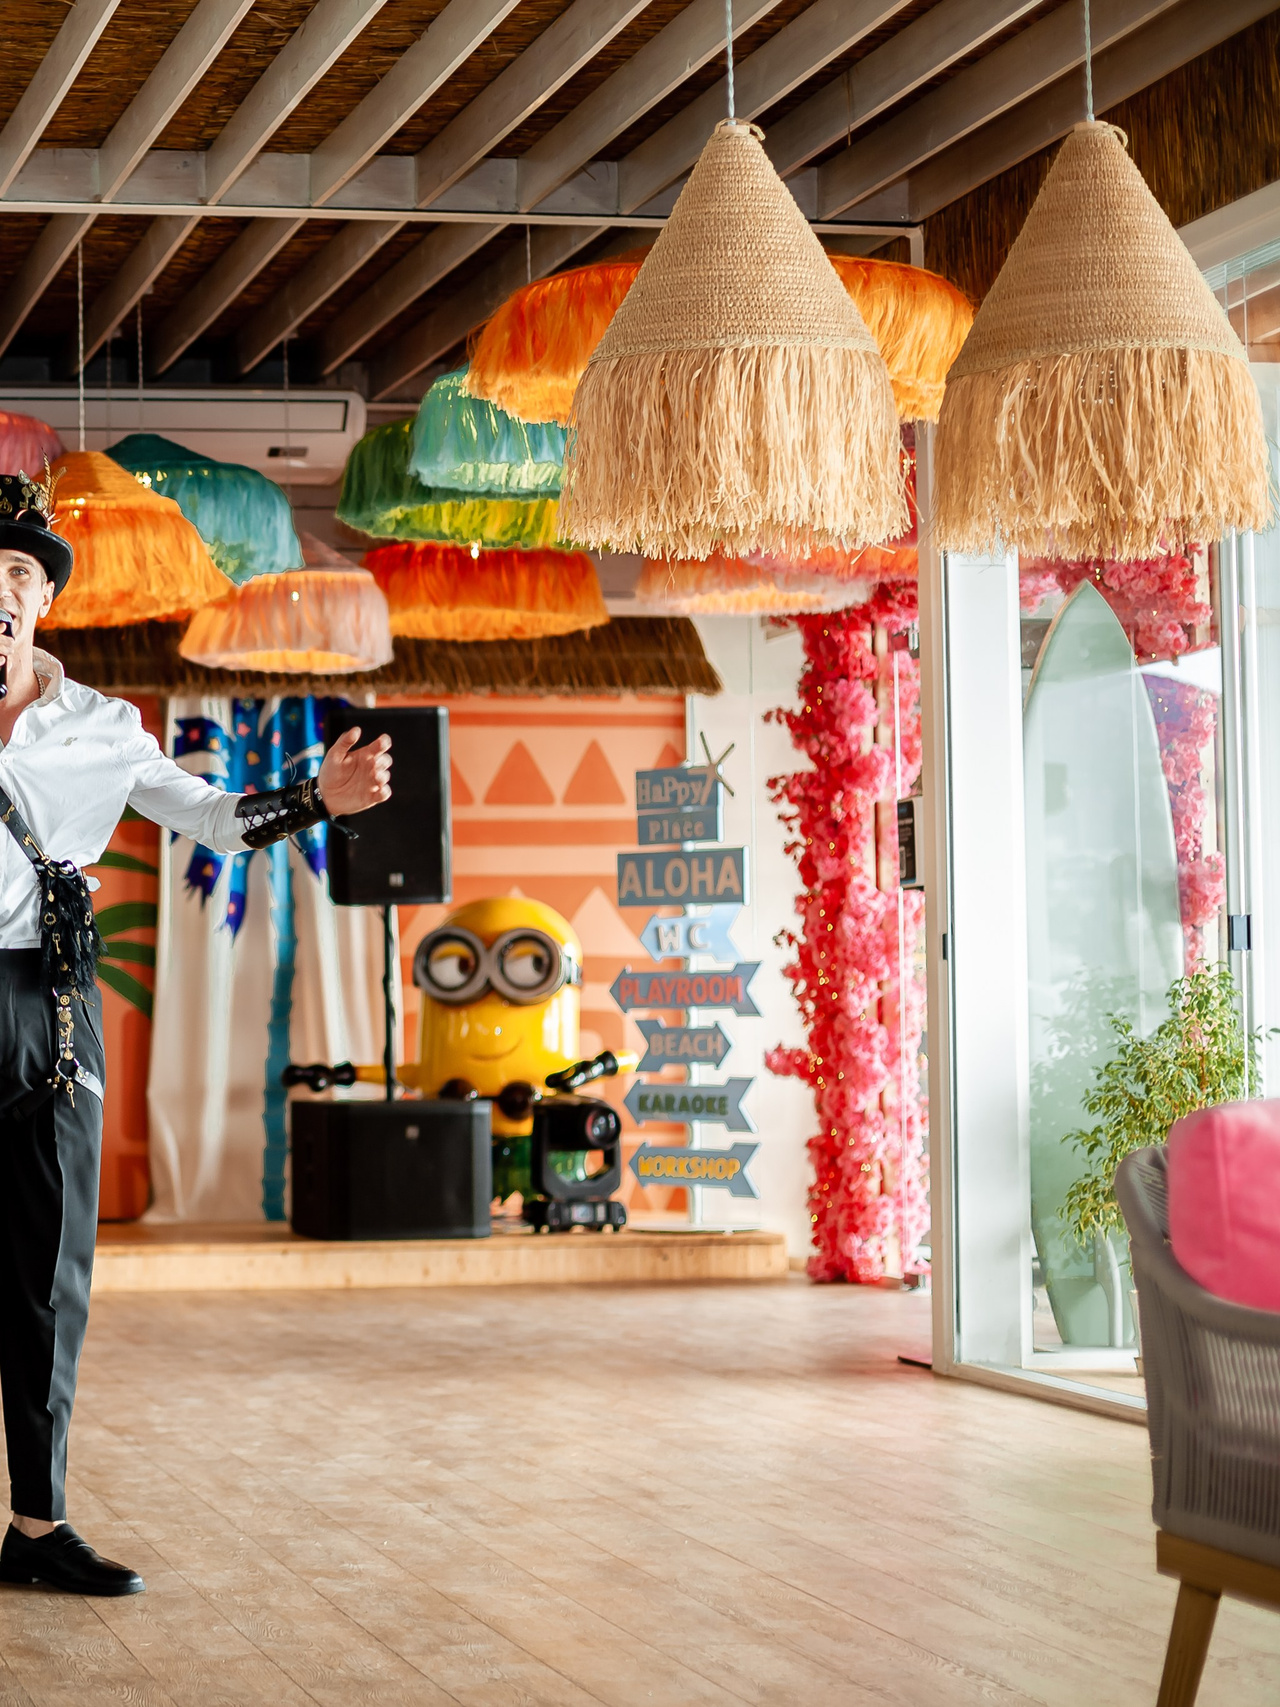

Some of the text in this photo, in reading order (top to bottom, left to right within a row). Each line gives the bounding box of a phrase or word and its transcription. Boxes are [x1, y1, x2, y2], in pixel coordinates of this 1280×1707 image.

[620, 856, 742, 899] ALOHA
[657, 923, 710, 952] WC
[620, 975, 743, 1005] PLAYROOM
[649, 1033, 723, 1057] BEACH
[638, 1093, 729, 1116] KARAOKE
[638, 1155, 741, 1180] WORKSHOP
